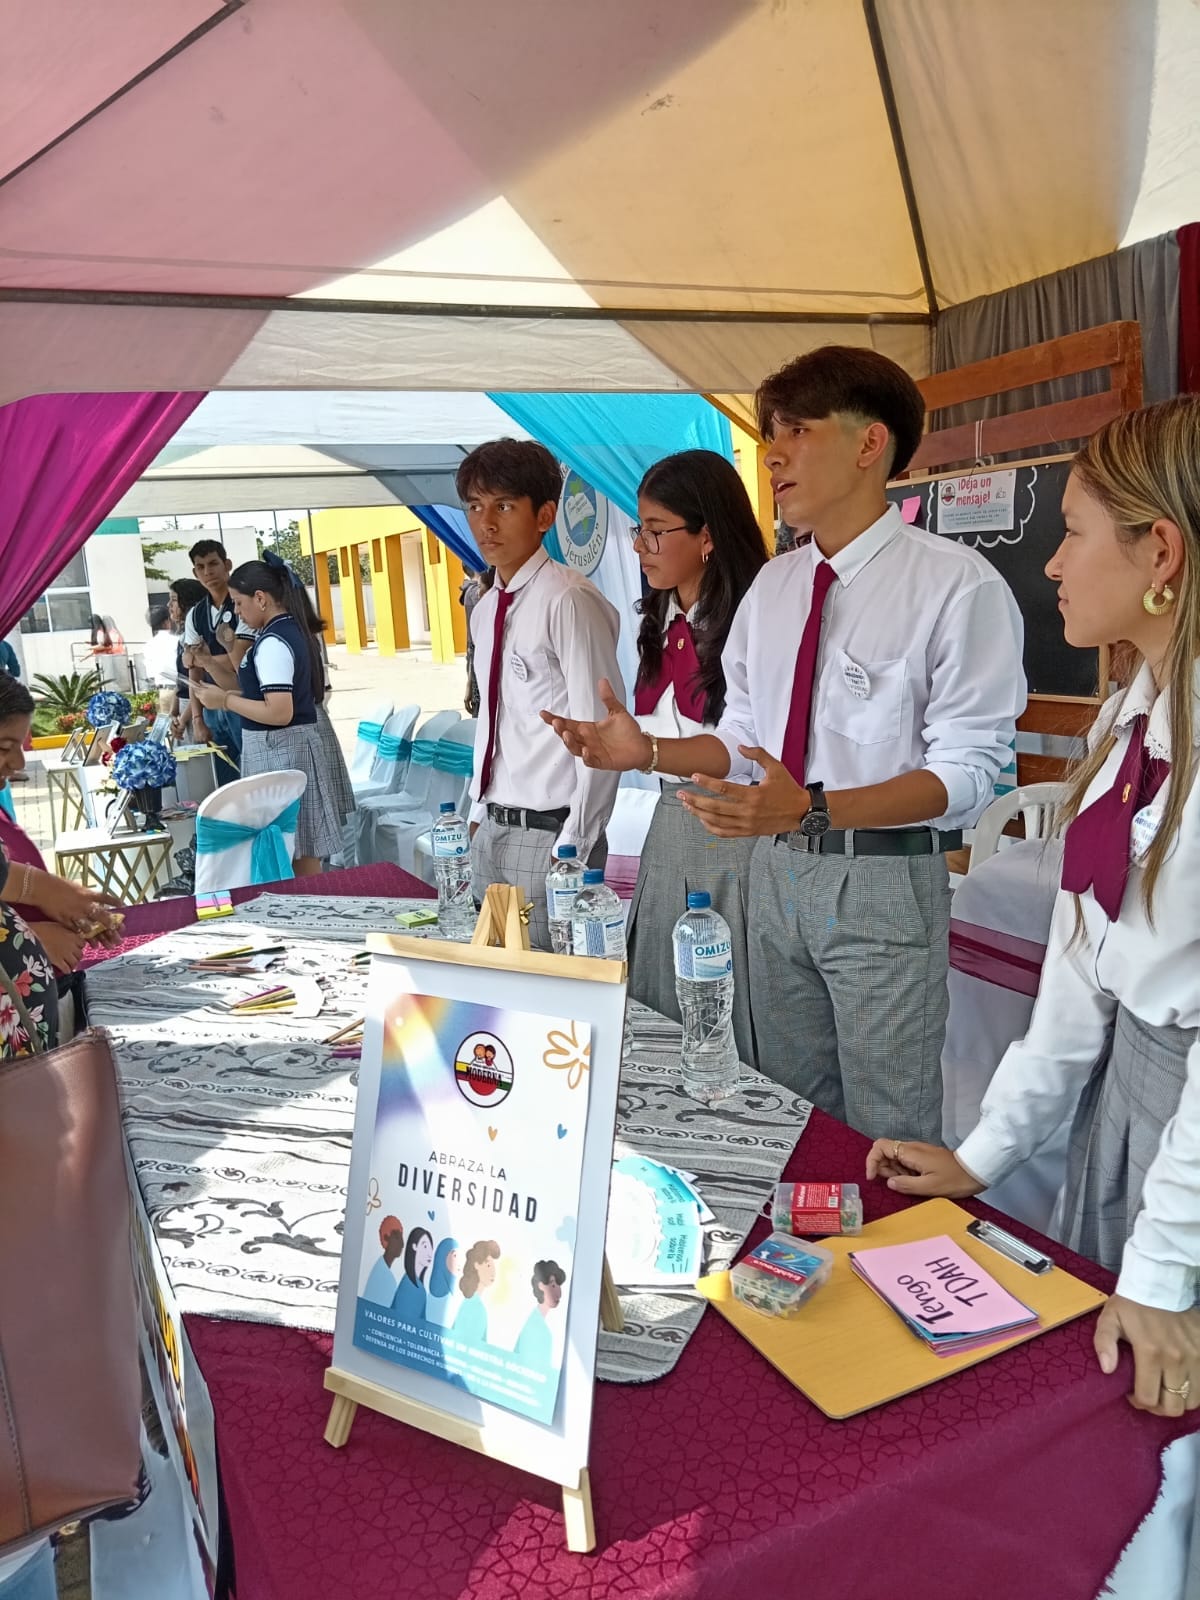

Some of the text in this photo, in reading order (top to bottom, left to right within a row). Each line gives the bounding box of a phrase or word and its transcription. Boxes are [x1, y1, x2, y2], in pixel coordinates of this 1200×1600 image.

[980, 477, 992, 487] un
[956, 490, 991, 509] mensaje!
[435, 833, 462, 842] OMIZU
[465, 1065, 503, 1087] MODERNA
[428, 1150, 507, 1181] ABRAZA LA
[398, 1162, 538, 1223] DIVERSIDAD
[924, 1256, 989, 1307] TDAH
[896, 1273, 954, 1325] Tengo
[364, 1309, 396, 1327] VALORES
[397, 1321, 417, 1335] PARA
[365, 1334, 435, 1366] DEFENSA DE LOS DERECHOS
[371, 1328, 441, 1358] CONCIENCIA TOLERANCIA
